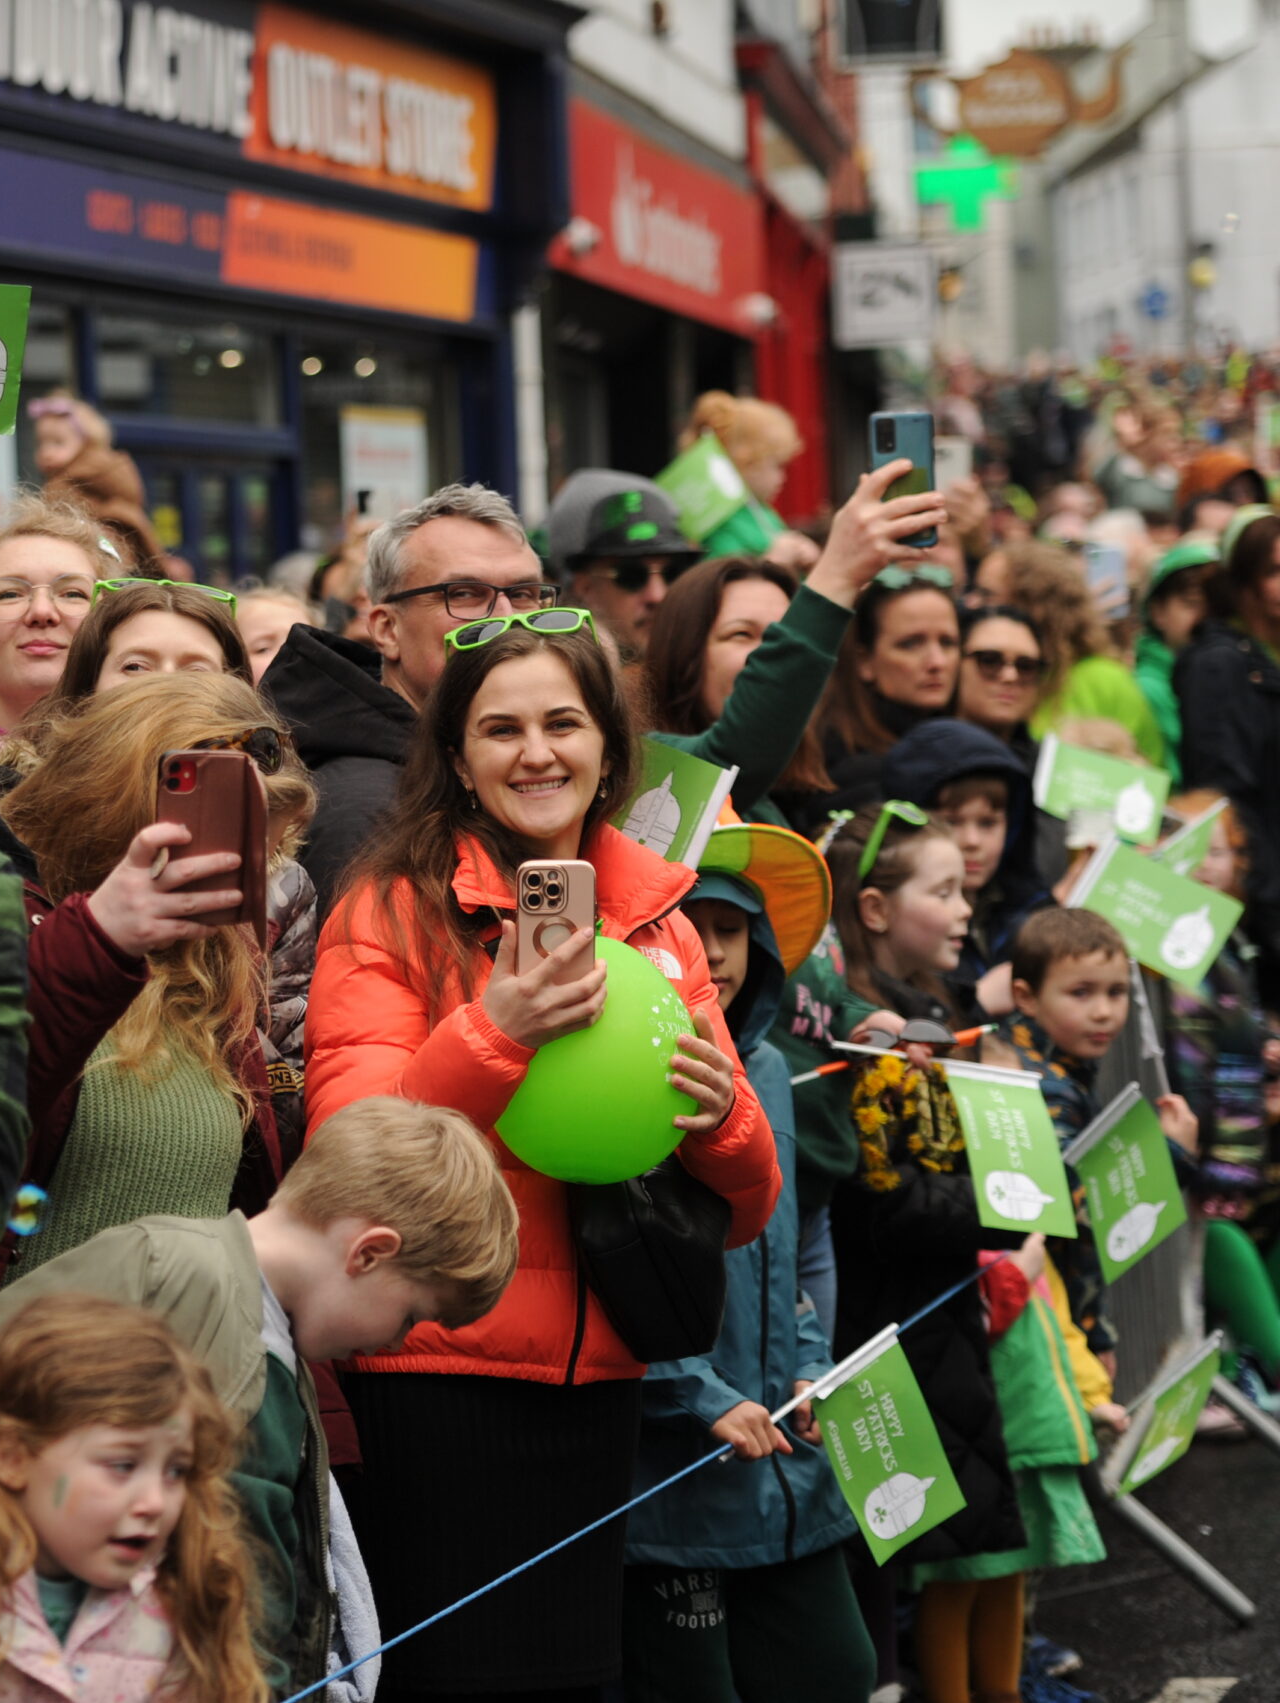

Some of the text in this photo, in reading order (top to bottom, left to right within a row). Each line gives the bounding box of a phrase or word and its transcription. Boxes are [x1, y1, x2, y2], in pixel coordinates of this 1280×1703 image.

[269, 40, 477, 191] OUTLET STORE
[852, 1417, 873, 1454] DAY!
[856, 1379, 898, 1473] ST PATRICKS
[879, 1392, 905, 1438] HAPPY
[654, 1571, 720, 1600] VARSI
[666, 1607, 725, 1629] FOOTBA
